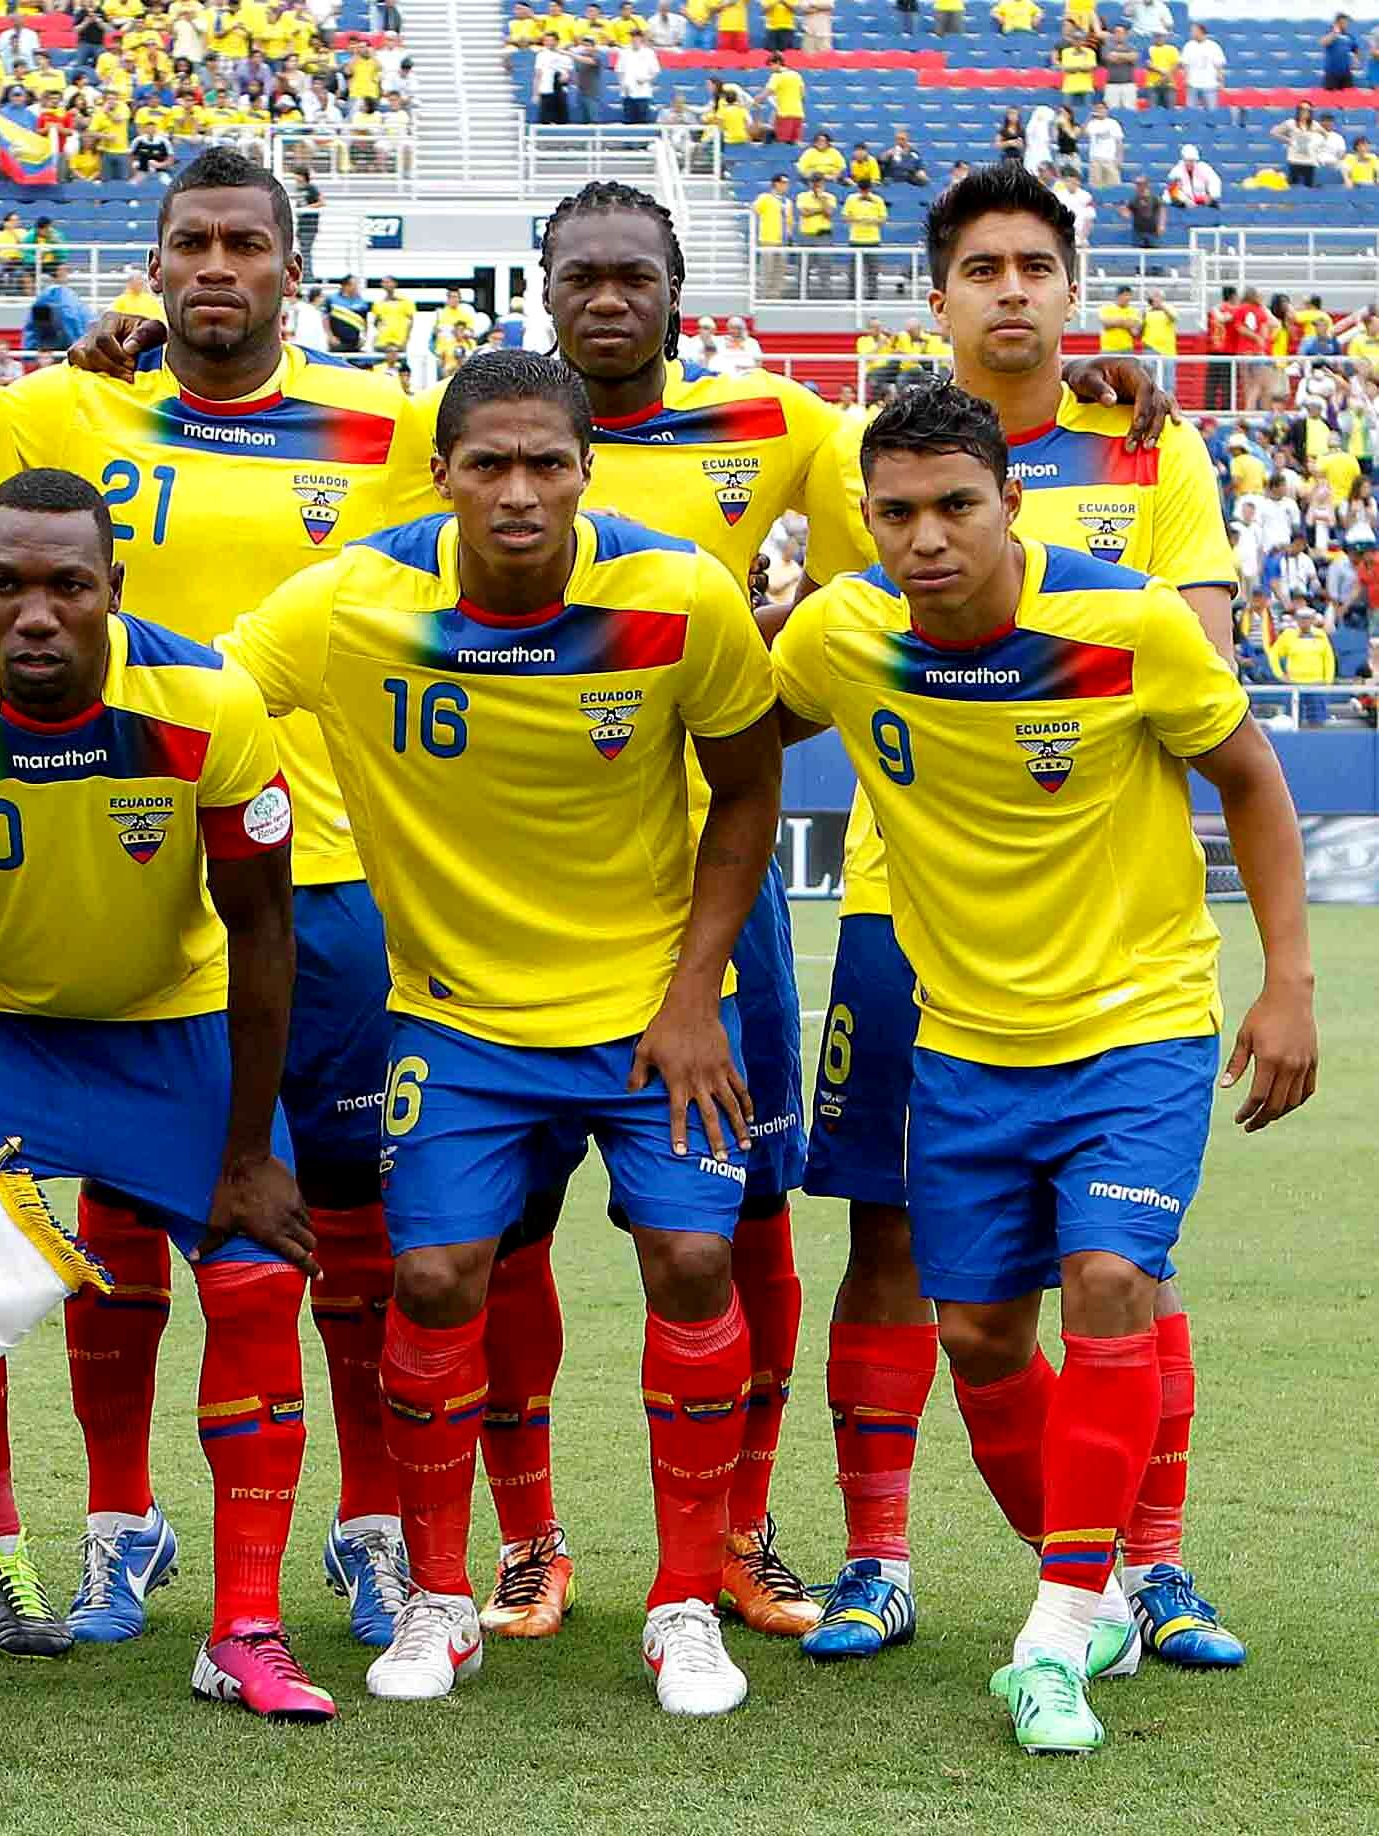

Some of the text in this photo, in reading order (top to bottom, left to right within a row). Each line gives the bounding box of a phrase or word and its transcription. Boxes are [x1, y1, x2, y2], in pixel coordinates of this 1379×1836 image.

[183, 423, 276, 446] marathon
[702, 458, 759, 470] ECUADOR
[1006, 463, 1058, 480] athon
[293, 475, 349, 488] ECUADOR
[102, 459, 176, 545] 21
[1078, 503, 1136, 513] ECUADOR
[458, 647, 555, 664] marathon
[926, 668, 1020, 684] marathon
[580, 690, 643, 704] ECUADOR
[383, 678, 469, 758] 16
[1015, 722, 1080, 735] ECUADOR
[872, 709, 914, 785] 9
[13, 747, 107, 770] marathon
[110, 797, 174, 809] ECUADOR
[336, 1092, 385, 1112] mara
[383, 1056, 429, 1136] 6
[1089, 1179, 1180, 1213] marathon
